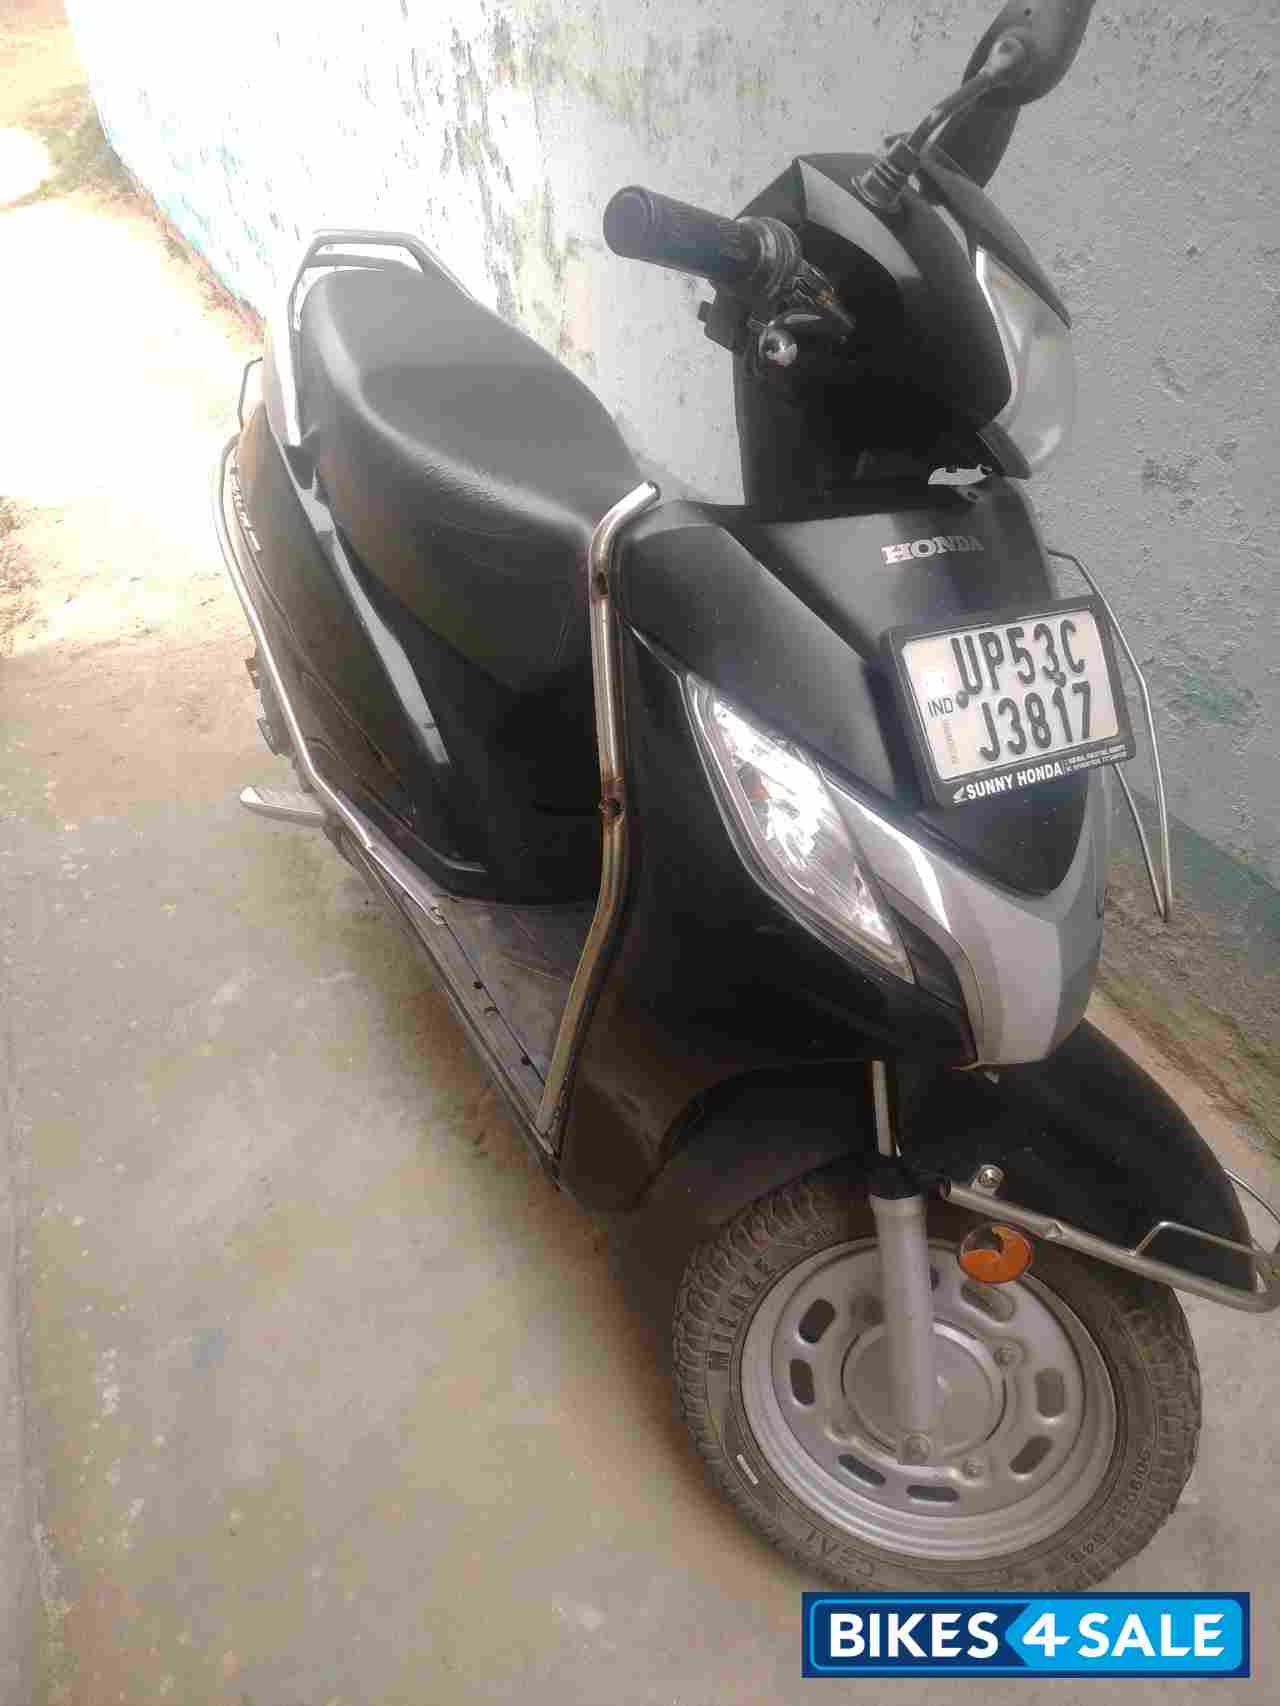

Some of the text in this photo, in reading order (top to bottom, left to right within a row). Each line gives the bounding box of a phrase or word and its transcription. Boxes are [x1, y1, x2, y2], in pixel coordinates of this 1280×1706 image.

[881, 536, 985, 564] HONDA
[951, 619, 1084, 696] UP53C
[927, 697, 954, 717] IND
[979, 681, 1091, 761] J3817
[966, 761, 1064, 801] SUNNY HONDA
